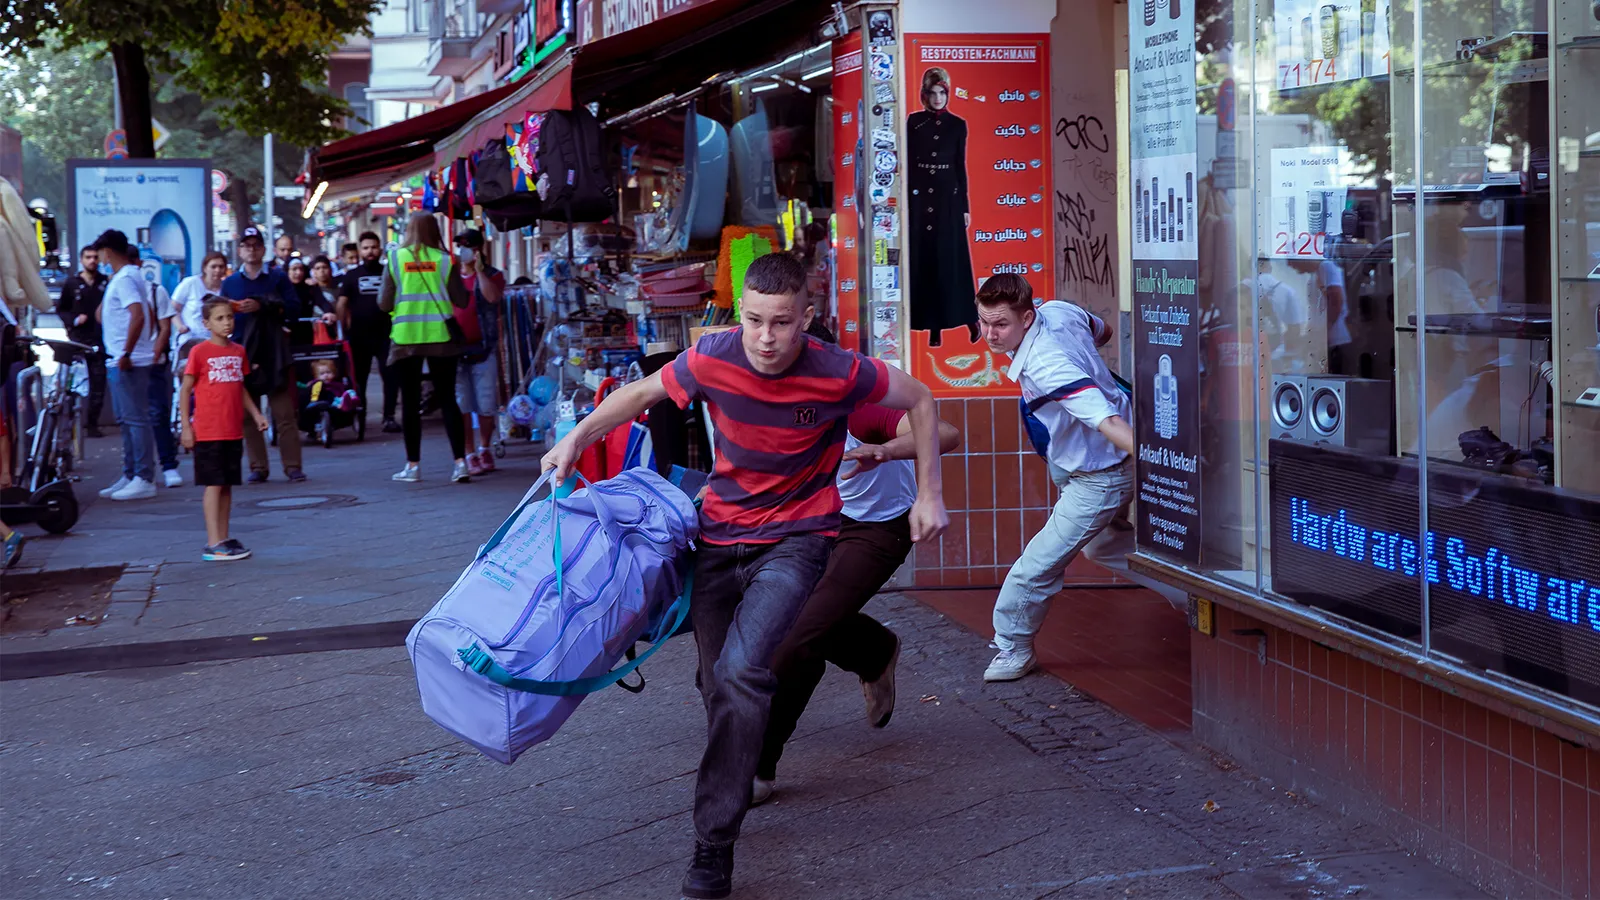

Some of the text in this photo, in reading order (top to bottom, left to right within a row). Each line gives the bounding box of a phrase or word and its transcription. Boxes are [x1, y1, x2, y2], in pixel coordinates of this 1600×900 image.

[921, 48, 1036, 60] RESTPOSTEN-FACHMANN
[1134, 44, 1191, 74] Ankauf & Verkauf
[994, 125, 1026, 137] جاكيت
[993, 159, 1027, 172] حجابات
[996, 194, 1027, 206] عبايات
[974, 229, 993, 242] جينز
[1161, 268, 1196, 302] Reparatur
[794, 407, 816, 425] M
[1139, 443, 1197, 473] Ankauf & Verkauf
